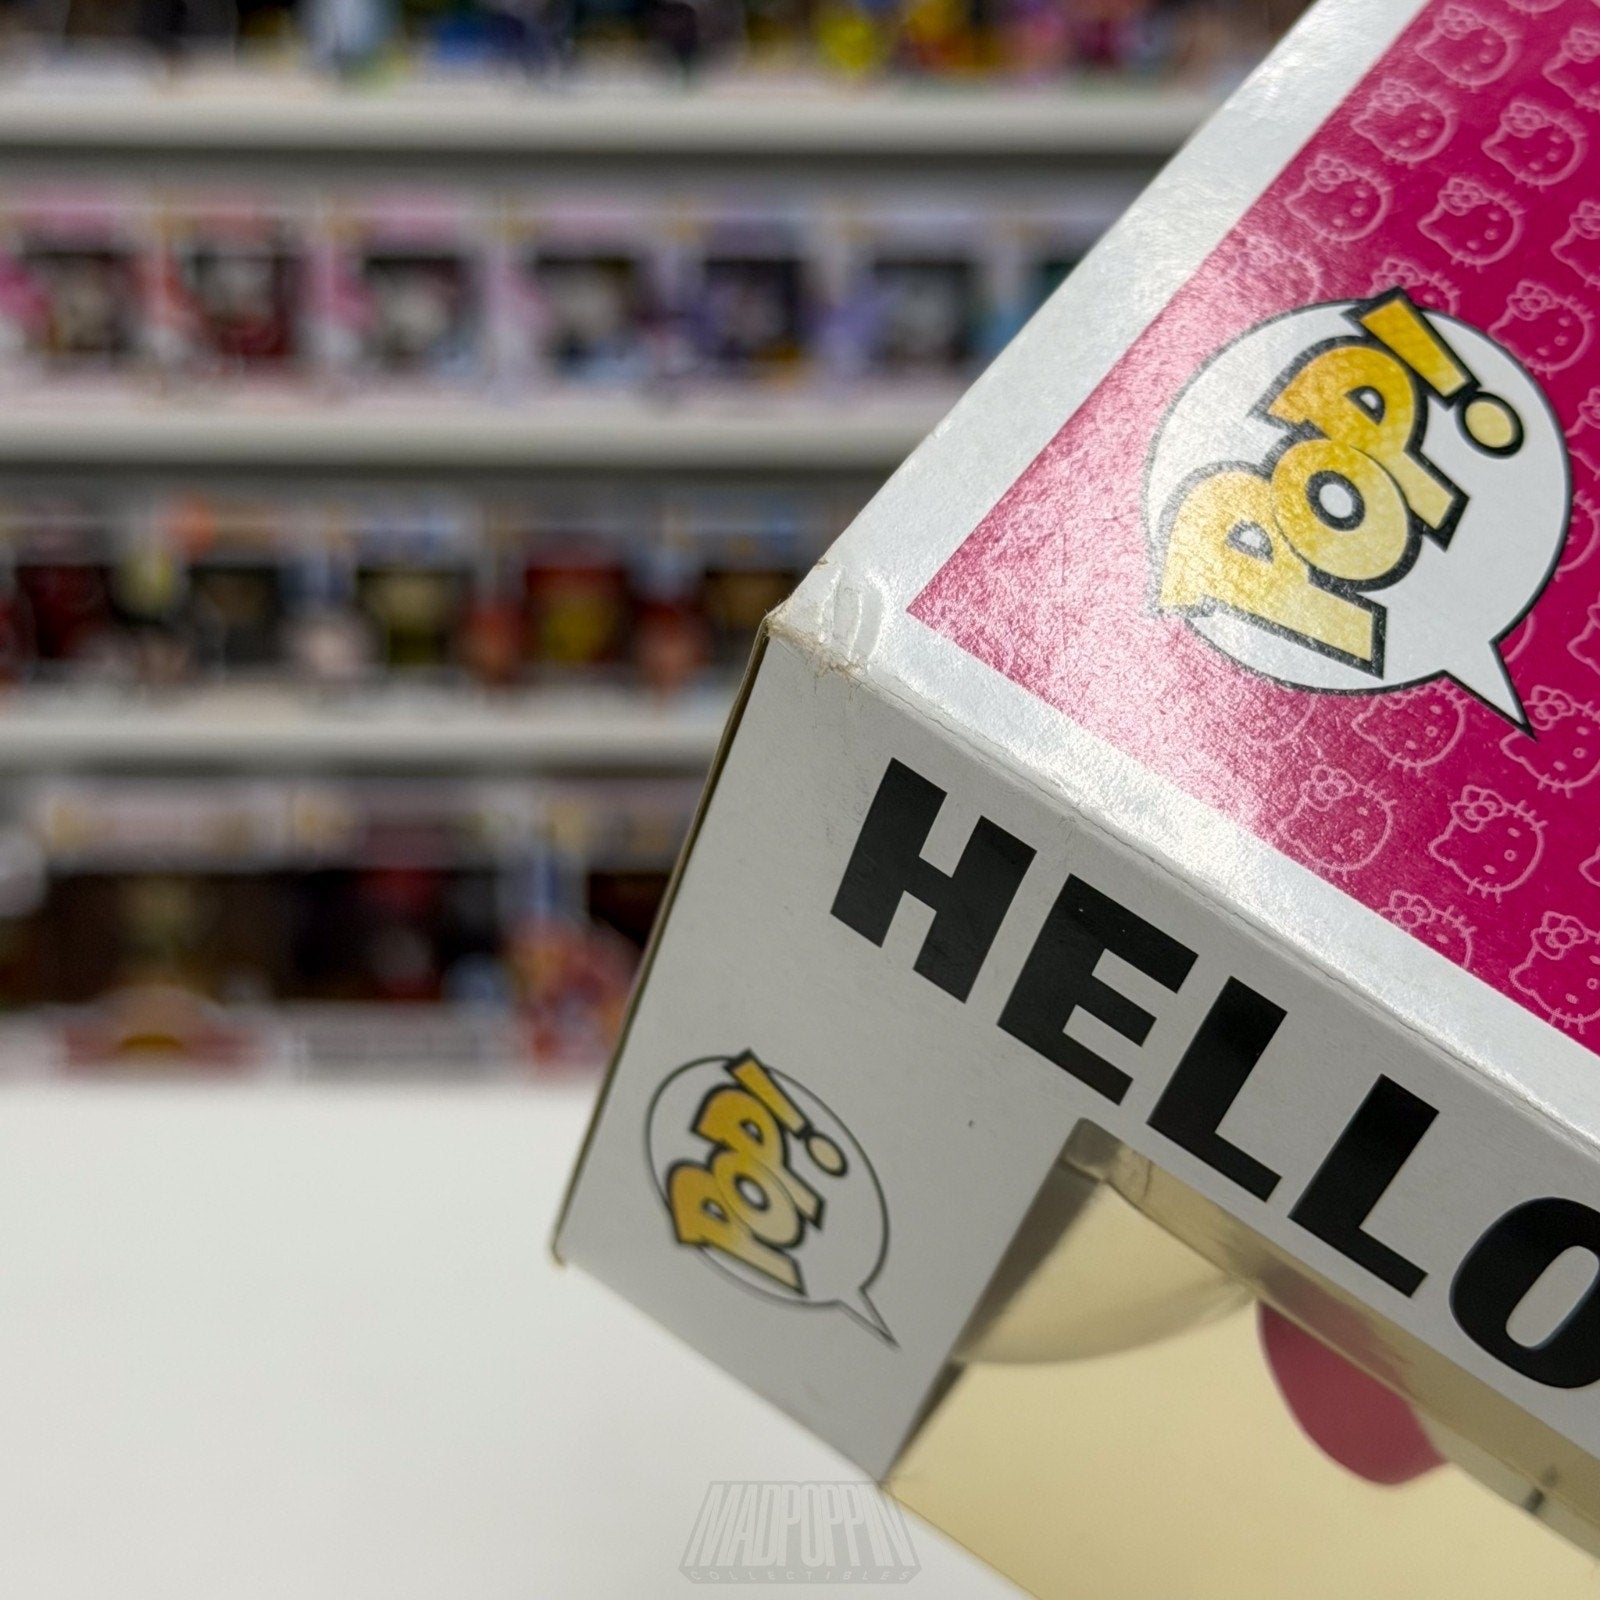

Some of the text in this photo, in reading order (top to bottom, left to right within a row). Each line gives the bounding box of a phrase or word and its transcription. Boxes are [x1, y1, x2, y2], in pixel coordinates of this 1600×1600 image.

[1156, 285, 1525, 679] POP!
[666, 1047, 848, 1296] POP!
[830, 757, 1600, 1389] HELLO
